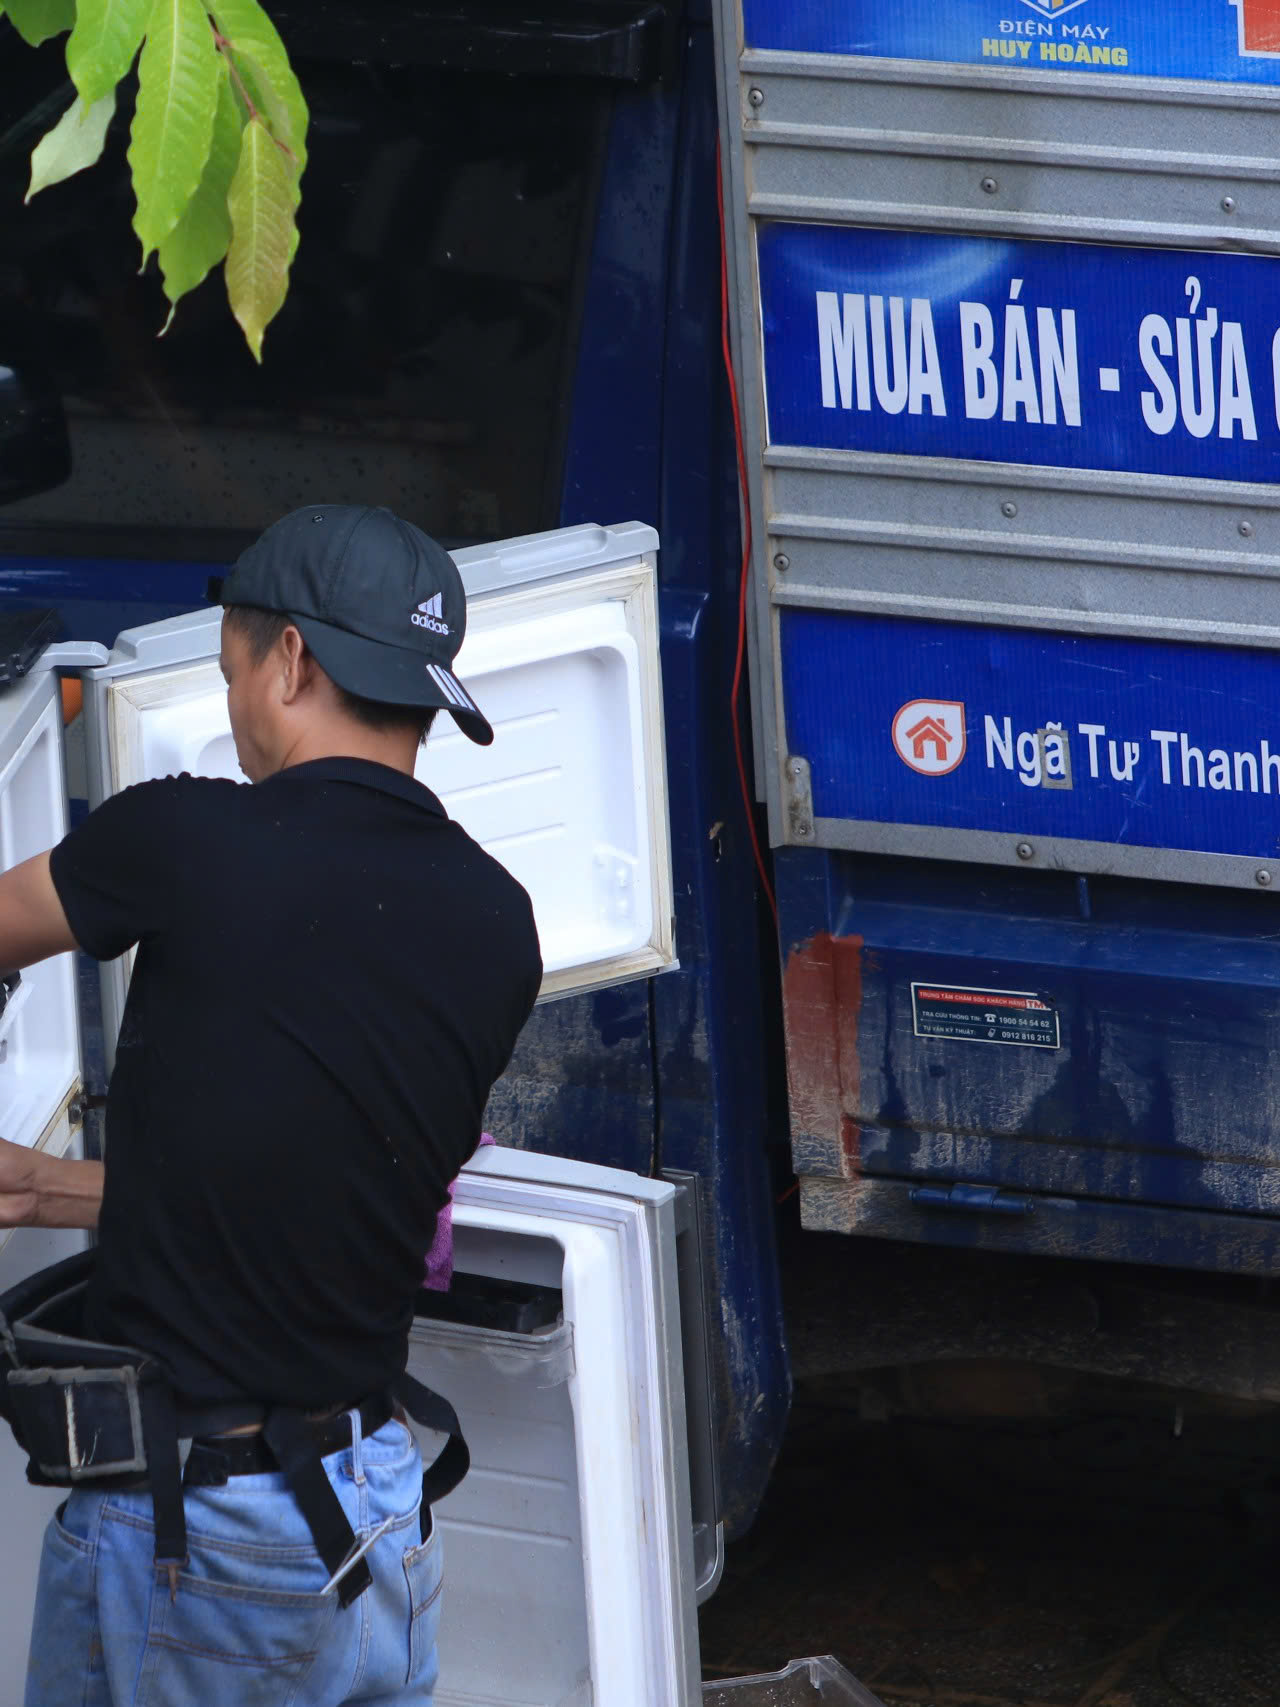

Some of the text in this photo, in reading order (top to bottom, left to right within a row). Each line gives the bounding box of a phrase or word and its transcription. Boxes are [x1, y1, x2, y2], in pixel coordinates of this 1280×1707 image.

[998, 19, 1110, 40] ĐIỆN MÁY
[981, 38, 1129, 66] HUY HOÀNG
[816, 290, 947, 417] MUA
[959, 278, 1082, 427] BÁN
[1138, 275, 1258, 441] SỬA
[410, 612, 450, 636] adidas
[984, 714, 1280, 795] Ngã Tư Thanh
[999, 1017, 1017, 1025] 1900
[1018, 1018, 1028, 1026] 54
[1029, 1019, 1039, 1027] 54
[1001, 1031, 1020, 1040] 0912
[1021, 1033, 1035, 1041] 816
[1036, 1034, 1051, 1042] 215
